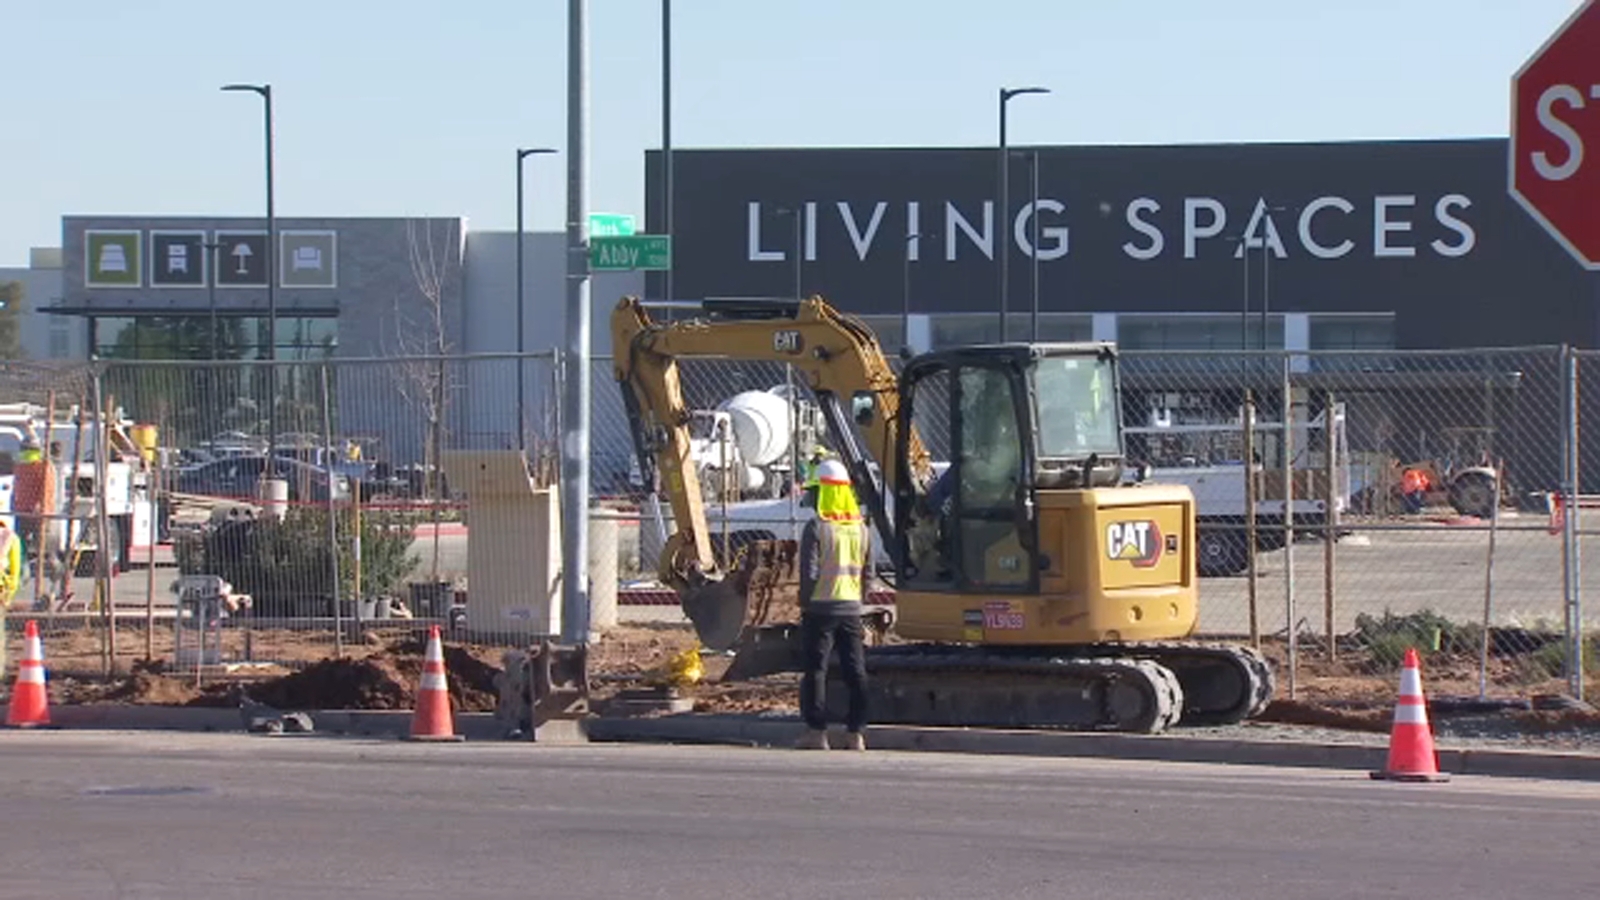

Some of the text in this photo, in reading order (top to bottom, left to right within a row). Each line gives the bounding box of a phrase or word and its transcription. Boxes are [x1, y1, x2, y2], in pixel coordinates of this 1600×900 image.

[1531, 84, 1600, 181] S
[749, 194, 1475, 261] LIVING SPACES
[774, 331, 799, 351] CAT
[1107, 522, 1150, 559] CAT
